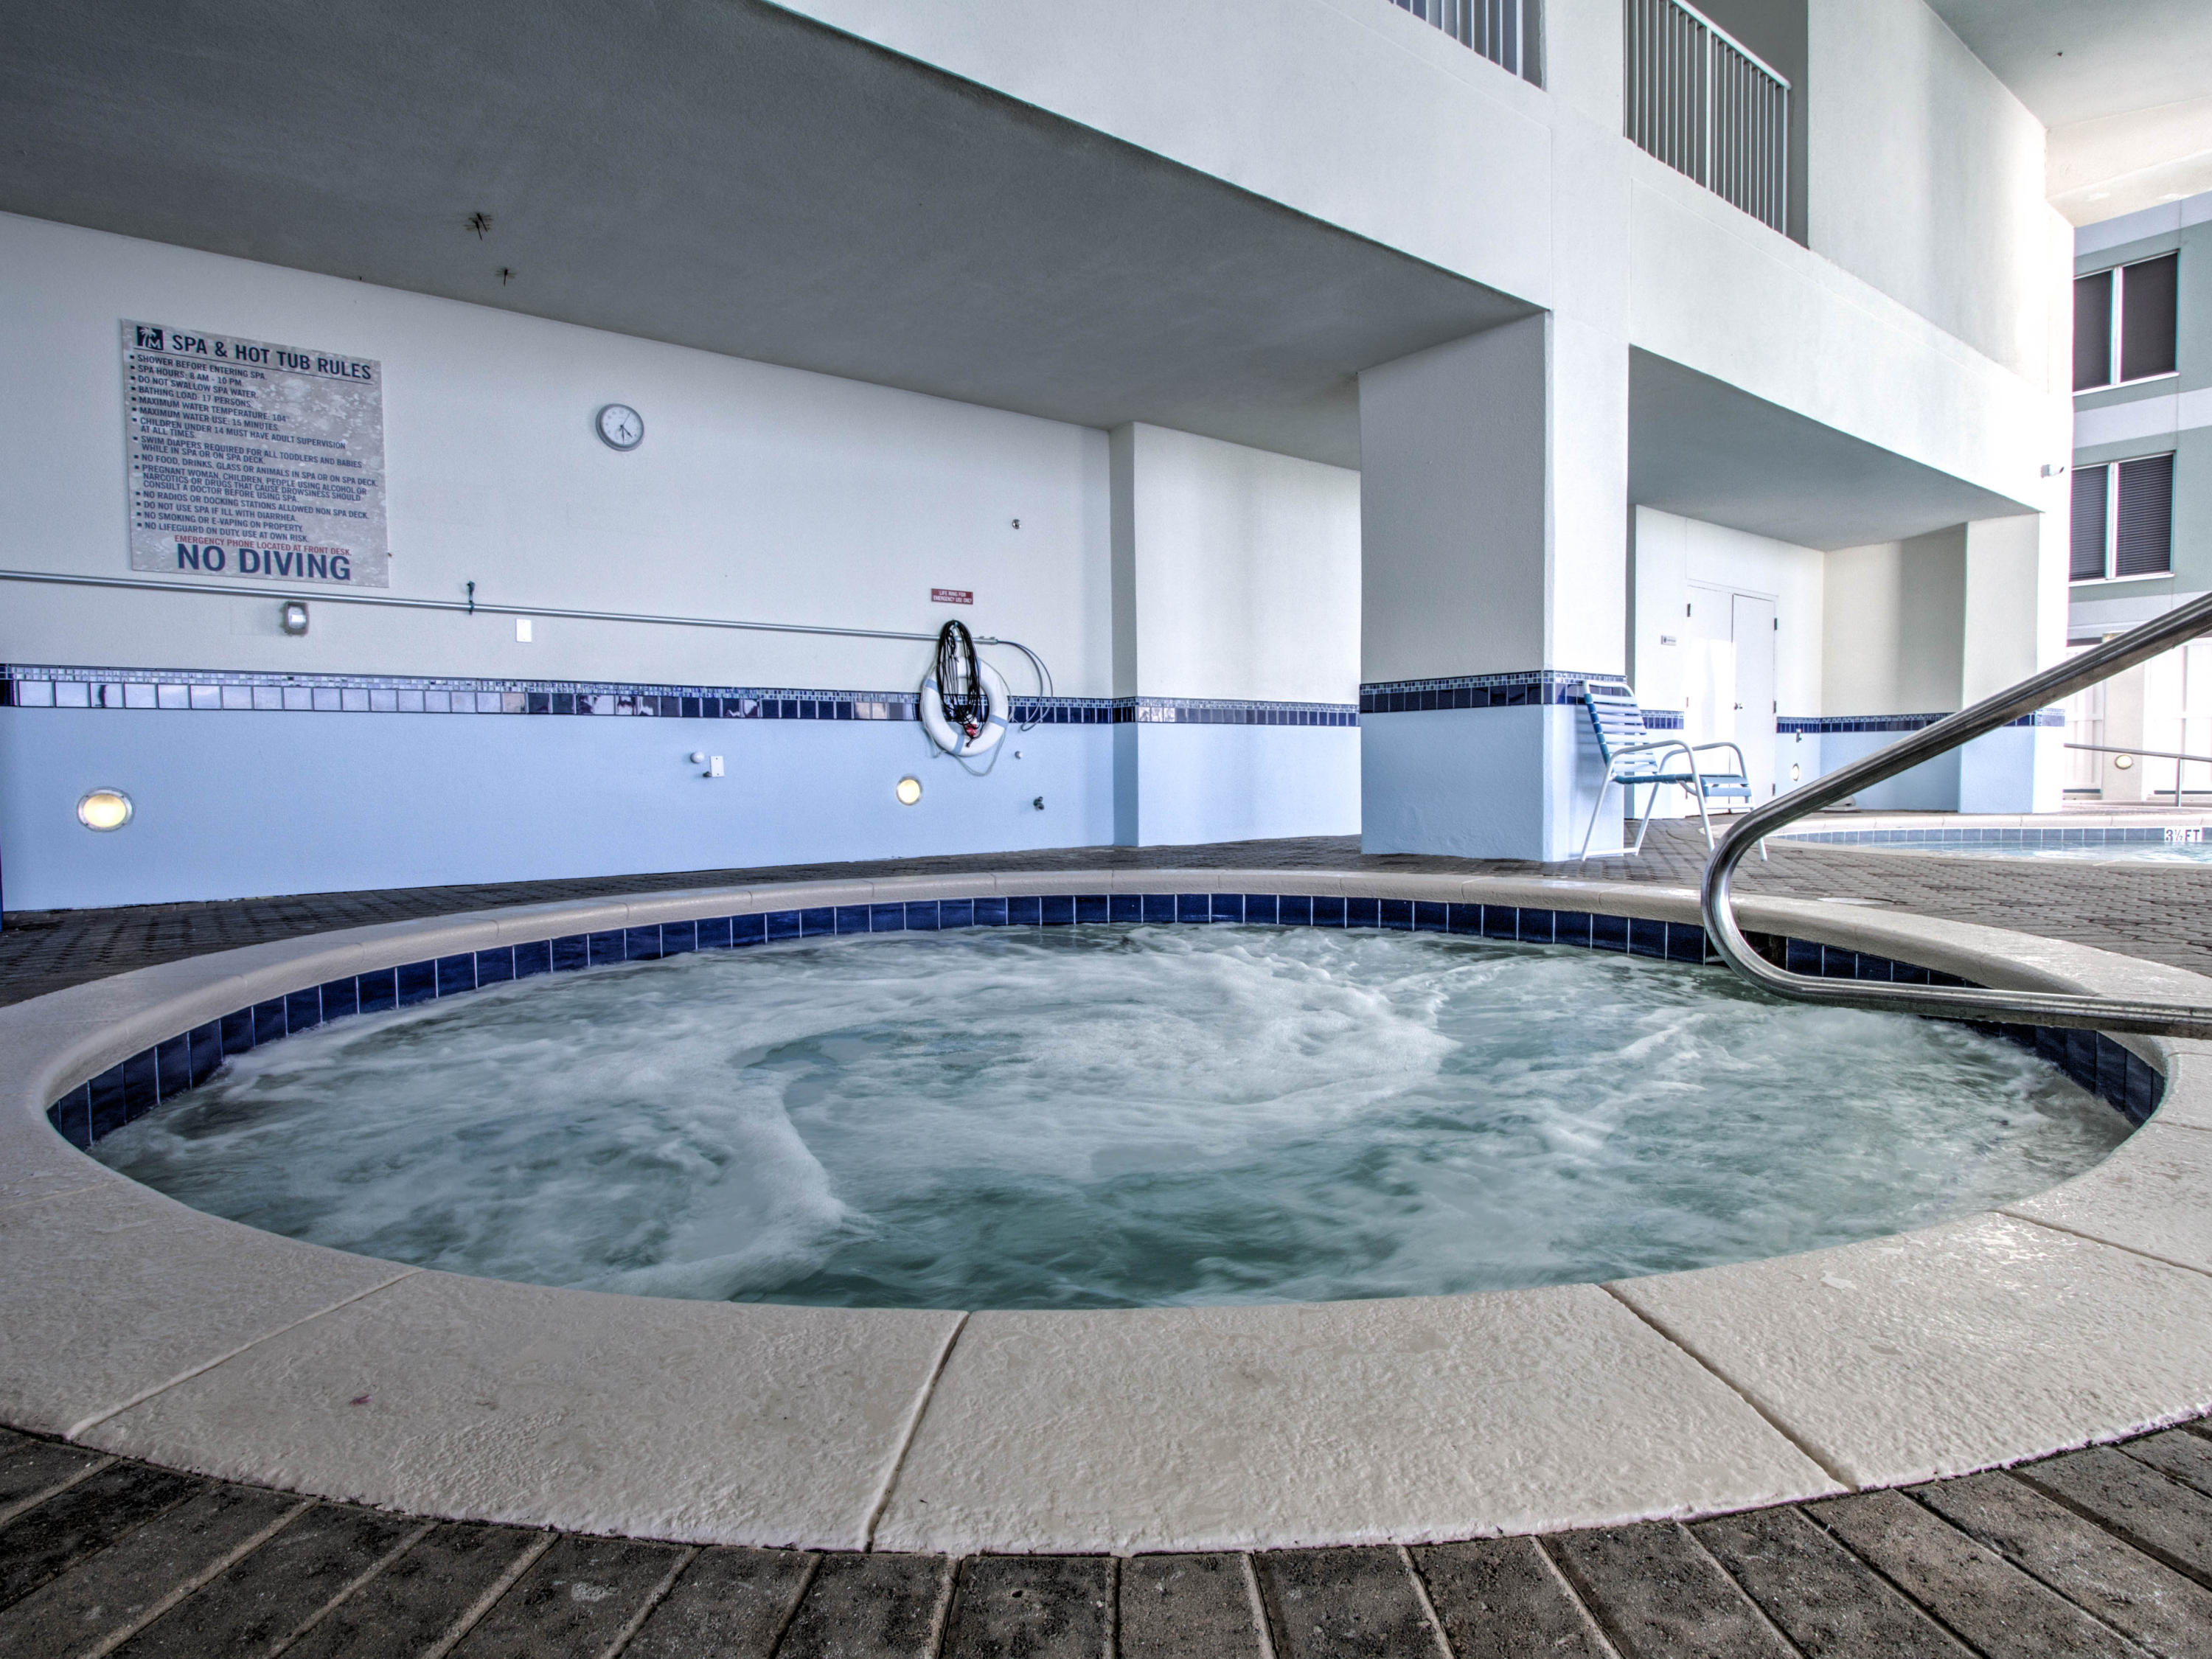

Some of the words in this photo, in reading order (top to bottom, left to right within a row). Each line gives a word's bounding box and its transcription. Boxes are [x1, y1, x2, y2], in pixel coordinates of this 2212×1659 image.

[138, 355, 173, 366] SHOWER
[176, 360, 207, 371] BEFORE
[210, 365, 248, 378] ENTERING
[173, 335, 207, 354] SPA
[215, 341, 228, 358] &
[236, 344, 270, 364] HOT
[276, 351, 310, 369] TUB
[318, 358, 371, 380] RULES
[139, 365, 153, 374] SPA
[157, 368, 187, 378] HOURS:
[218, 376, 227, 384] 10
[139, 375, 150, 383] DO
[153, 378, 168, 386] NOT
[171, 380, 210, 392] SWALLOW
[213, 386, 228, 394] SPA
[139, 386, 174, 397] BATHING
[139, 397, 179, 408] MAXIMUM
[182, 403, 209, 411] WATER
[140, 406, 180, 418] MAXIMUM
[183, 412, 209, 422] WATER
[141, 417, 181, 429] CHILDREN
[185, 423, 212, 434] UNDER
[226, 428, 248, 437] MUST
[250, 430, 269, 440] HAVE
[271, 434, 294, 442] ADULT
[297, 437, 346, 449] SUPERVISION
[153, 427, 167, 435] ALL
[142, 436, 164, 445] SWIM
[167, 439, 201, 449] DIAPERS
[205, 443, 244, 453] REQUIRED
[279, 452, 319, 463] TODDLERS
[337, 459, 362, 468] BABIES
[142, 444, 168, 453] WHILE
[171, 446, 179, 454] IN
[227, 453, 241, 462] SPA
[243, 455, 265, 465] DECK.
[142, 465, 184, 476] PREGNANT
[266, 478, 295, 487] PEOPLE
[298, 481, 320, 490] USING
[323, 484, 355, 493] ALCOHOL
[156, 456, 180, 466] FOOD,
[182, 459, 214, 469] DRINKS,
[217, 462, 241, 472] GLASS
[257, 467, 289, 477] ANIMALS
[358, 479, 378, 487] DECK.
[143, 473, 189, 484] NARCOTICS
[205, 479, 232, 488] DRUGS
[234, 482, 252, 490] THAT
[255, 484, 279, 493] CAUSE
[282, 487, 330, 498] DROWSINESS
[333, 493, 361, 501] SHOULD
[143, 481, 181, 490] CONSULT
[190, 485, 222, 494] DOCTOR
[225, 489, 254, 498] BEFORE
[257, 493, 280, 501] USING
[158, 493, 187, 501] RADIOS
[204, 496, 238, 507] DOCKING
[241, 501, 276, 510] STATIONS
[279, 504, 313, 513] ALLOWED
[349, 511, 369, 519] DECK.
[177, 504, 192, 512] USE
[195, 506, 209, 514] SPA
[159, 513, 195, 523] SMOKING
[212, 518, 248, 527] E-VAPING
[159, 524, 204, 534] LIFEGUARD
[271, 532, 288, 540] OWN
[175, 535, 224, 546] EMERGENCY
[227, 539, 254, 548] PHONE
[257, 542, 291, 551] LOCATED
[304, 546, 328, 554] FRONT
[177, 543, 226, 571] NO
[239, 548, 350, 580] DIVING
[2184, 829, 2200, 843] FT
